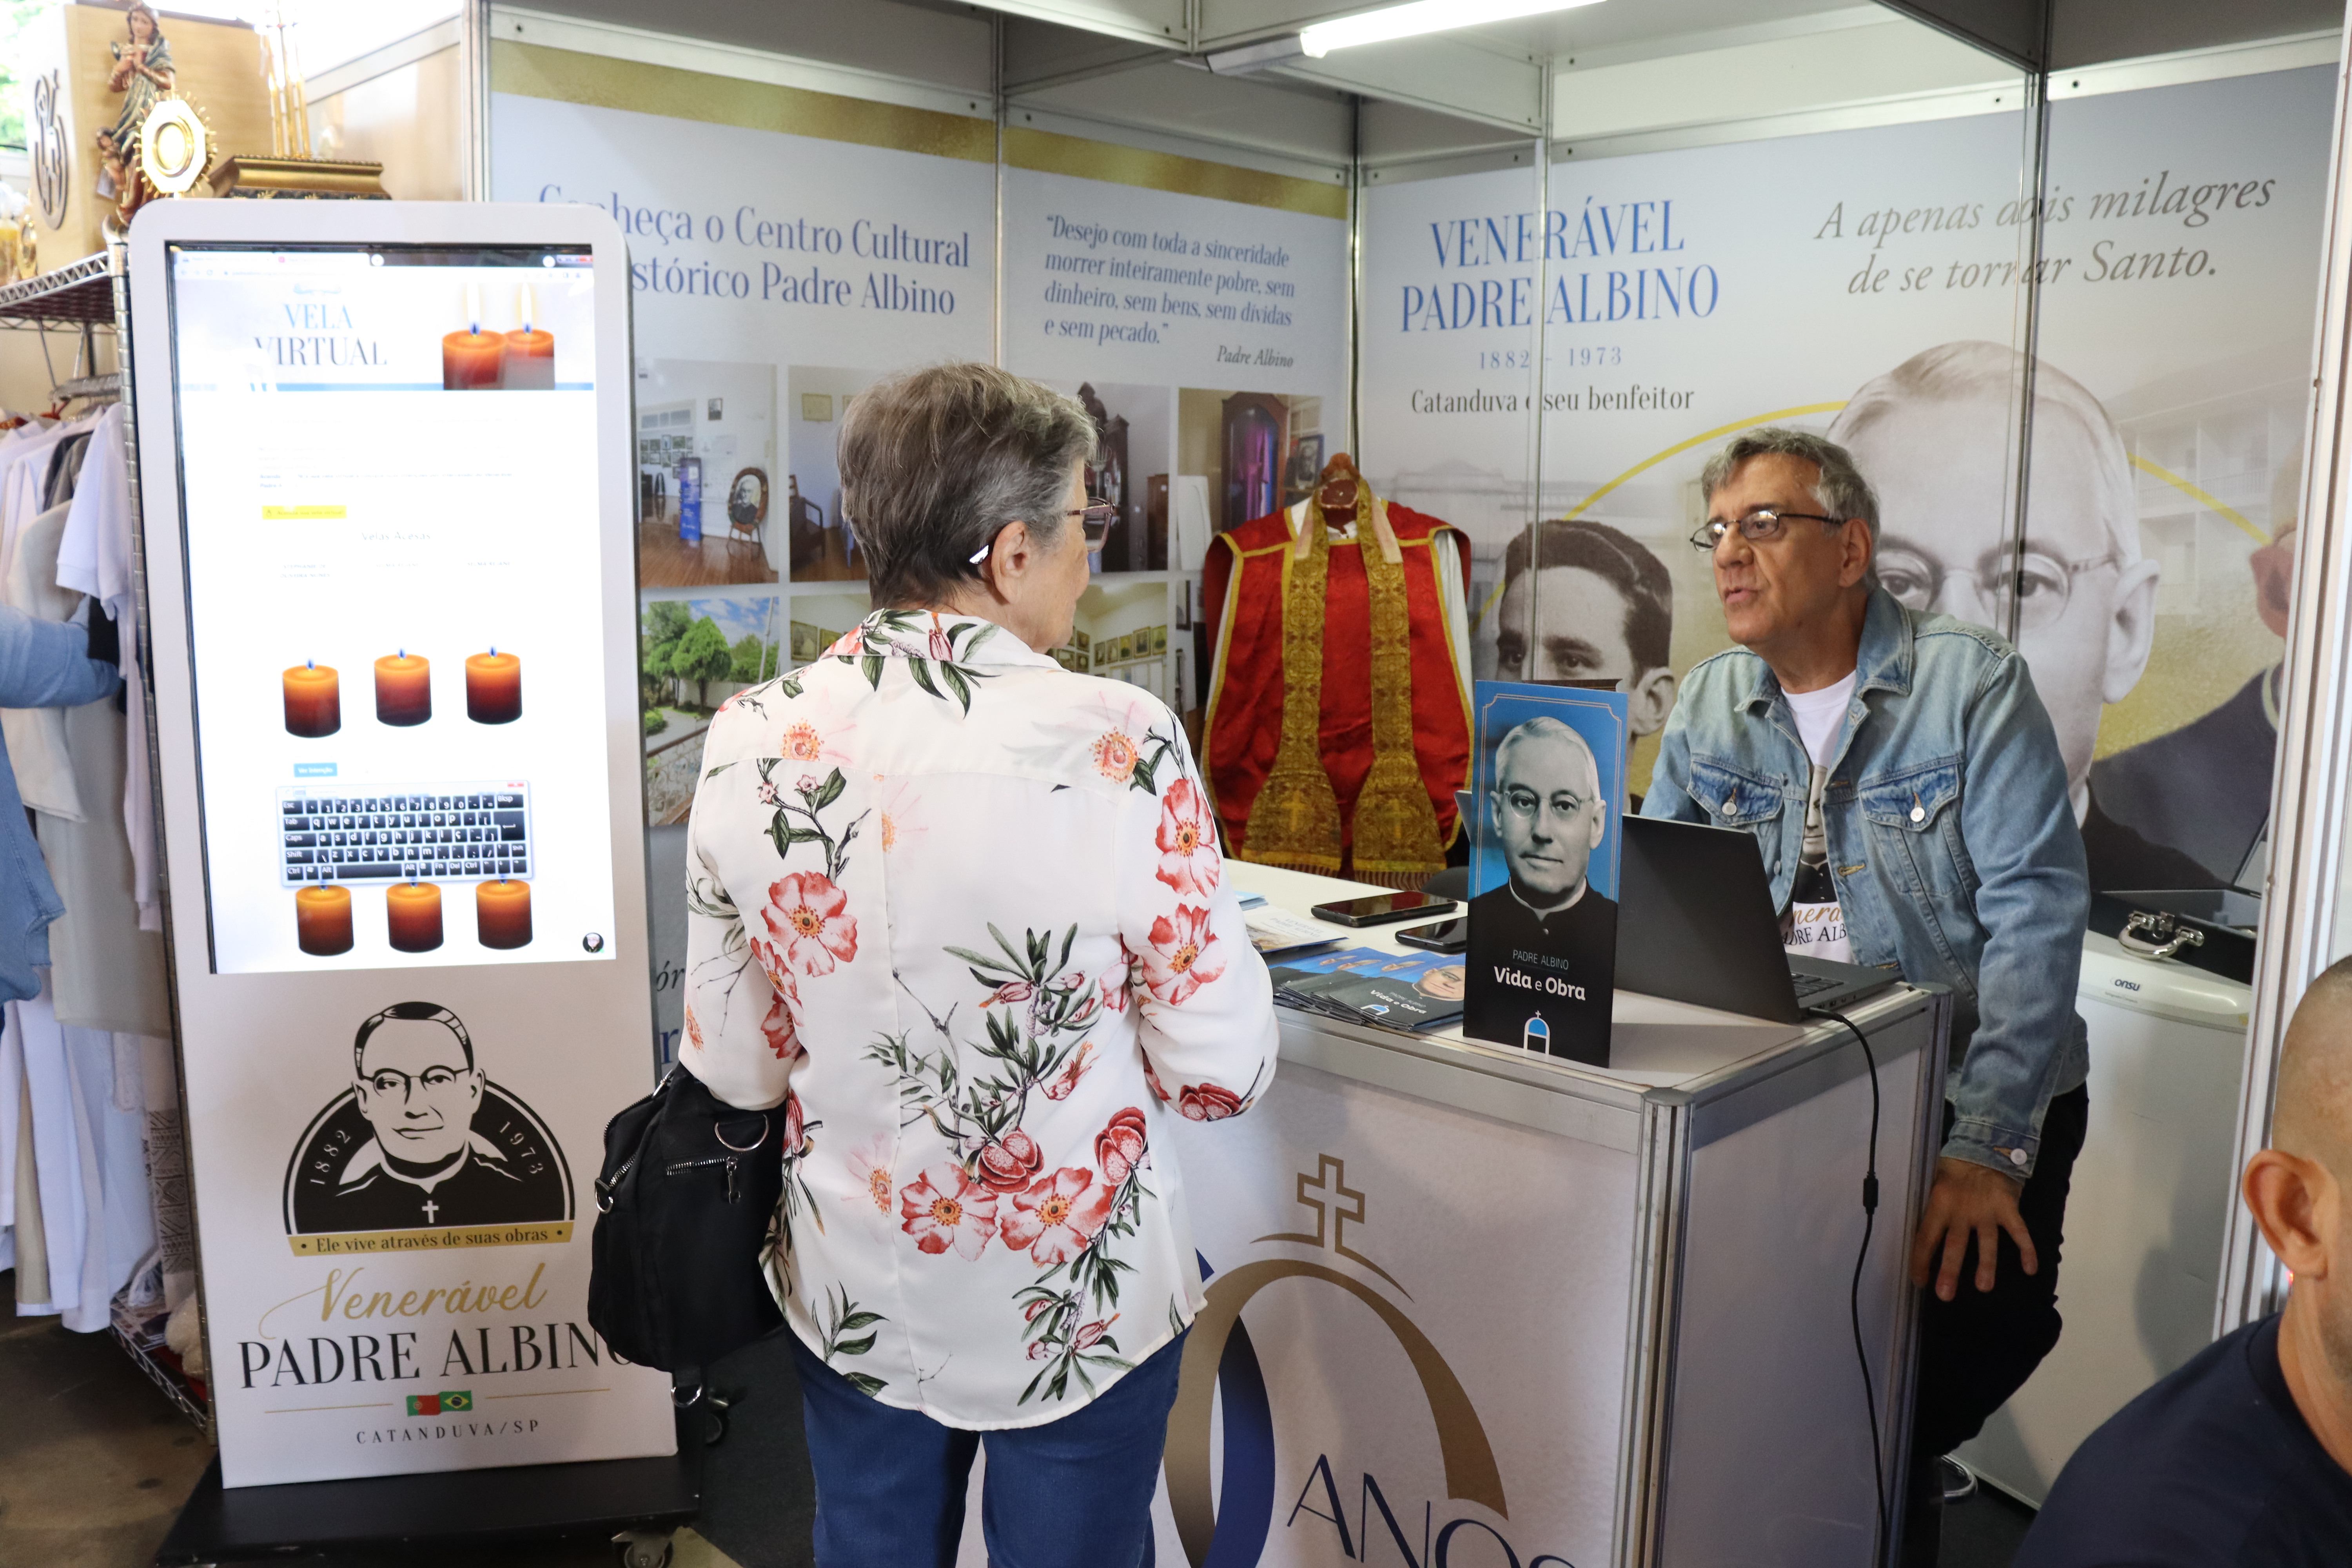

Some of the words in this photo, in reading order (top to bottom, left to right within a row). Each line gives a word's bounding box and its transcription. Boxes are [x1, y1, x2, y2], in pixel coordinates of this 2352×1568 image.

[1814, 201, 1844, 240] A
[1857, 203, 1984, 249] apenas
[2090, 171, 2276, 227] milagres
[706, 214, 723, 242] o
[736, 206, 842, 255] Centro
[852, 218, 969, 267] Cultural
[1112, 229, 1147, 249] com
[1153, 232, 1187, 254] toda
[1192, 241, 1200, 256] a
[1205, 240, 1290, 267] sinceridade
[1429, 196, 1684, 269] VENERÁVEL
[1046, 253, 1106, 274] morrer
[1110, 258, 1212, 288] inteiramente
[1216, 272, 1261, 295] pobre,
[1265, 279, 1294, 298] sem
[1848, 254, 1889, 294] de
[1900, 263, 1932, 291] se
[1945, 258, 2072, 289] tornar
[2085, 240, 2217, 283] Santo.
[632, 257, 749, 299] stórico
[762, 261, 851, 307] Padre
[861, 272, 955, 315] Albino
[1045, 280, 1118, 310] dinheiro,
[1124, 294, 1156, 312] sem
[1162, 293, 1201, 318] bens,
[1206, 303, 1236, 321] sem
[1401, 277, 1532, 332] PADRE
[1545, 264, 1719, 325] ALBINO
[283, 303, 353, 329] VELA
[1045, 318, 1054, 335] e
[1059, 320, 1094, 338] sem
[253, 336, 387, 366] VIRTUAL
[1217, 345, 1251, 365] Padre
[1254, 349, 1294, 367] Albino
[1480, 350, 1530, 370] 1882
[1568, 347, 1622, 367] 1973
[1412, 389, 1517, 414] Catanduva
[1543, 393, 1579, 411] seu
[1589, 384, 1695, 412] benfeitor
[361, 531, 389, 541] Velas
[395, 531, 431, 541] Acesas
[314, 818, 320, 828] q
[388, 817, 395, 826] y
[449, 815, 456, 823] p
[380, 833, 387, 842] g
[425, 830, 431, 838] k
[1513, 949, 1538, 964] PADRE
[1541, 955, 1569, 970] ALBINO
[1370, 989, 1394, 1003] Vida
[1401, 1004, 1427, 1014] Obra
[1494, 965, 1532, 989] Vida
[1535, 980, 1542, 991] e
[1545, 977, 1586, 1001] Obra
[310, 1129, 350, 1185] 1882
[499, 1121, 544, 1175] 1973
[317, 1238, 341, 1253] Ele
[344, 1237, 376, 1251] vive
[380, 1232, 438, 1249] através
[442, 1232, 461, 1247] de
[465, 1232, 501, 1247] suas
[505, 1227, 549, 1243] obras
[259, 1263, 547, 1340] Venerável
[238, 1332, 420, 1389] PADRE
[440, 1322, 632, 1377] ALBIN
[356, 1419, 539, 1445] CATANDUVA/SP
[1287, 1454, 1576, 1568] ANO
